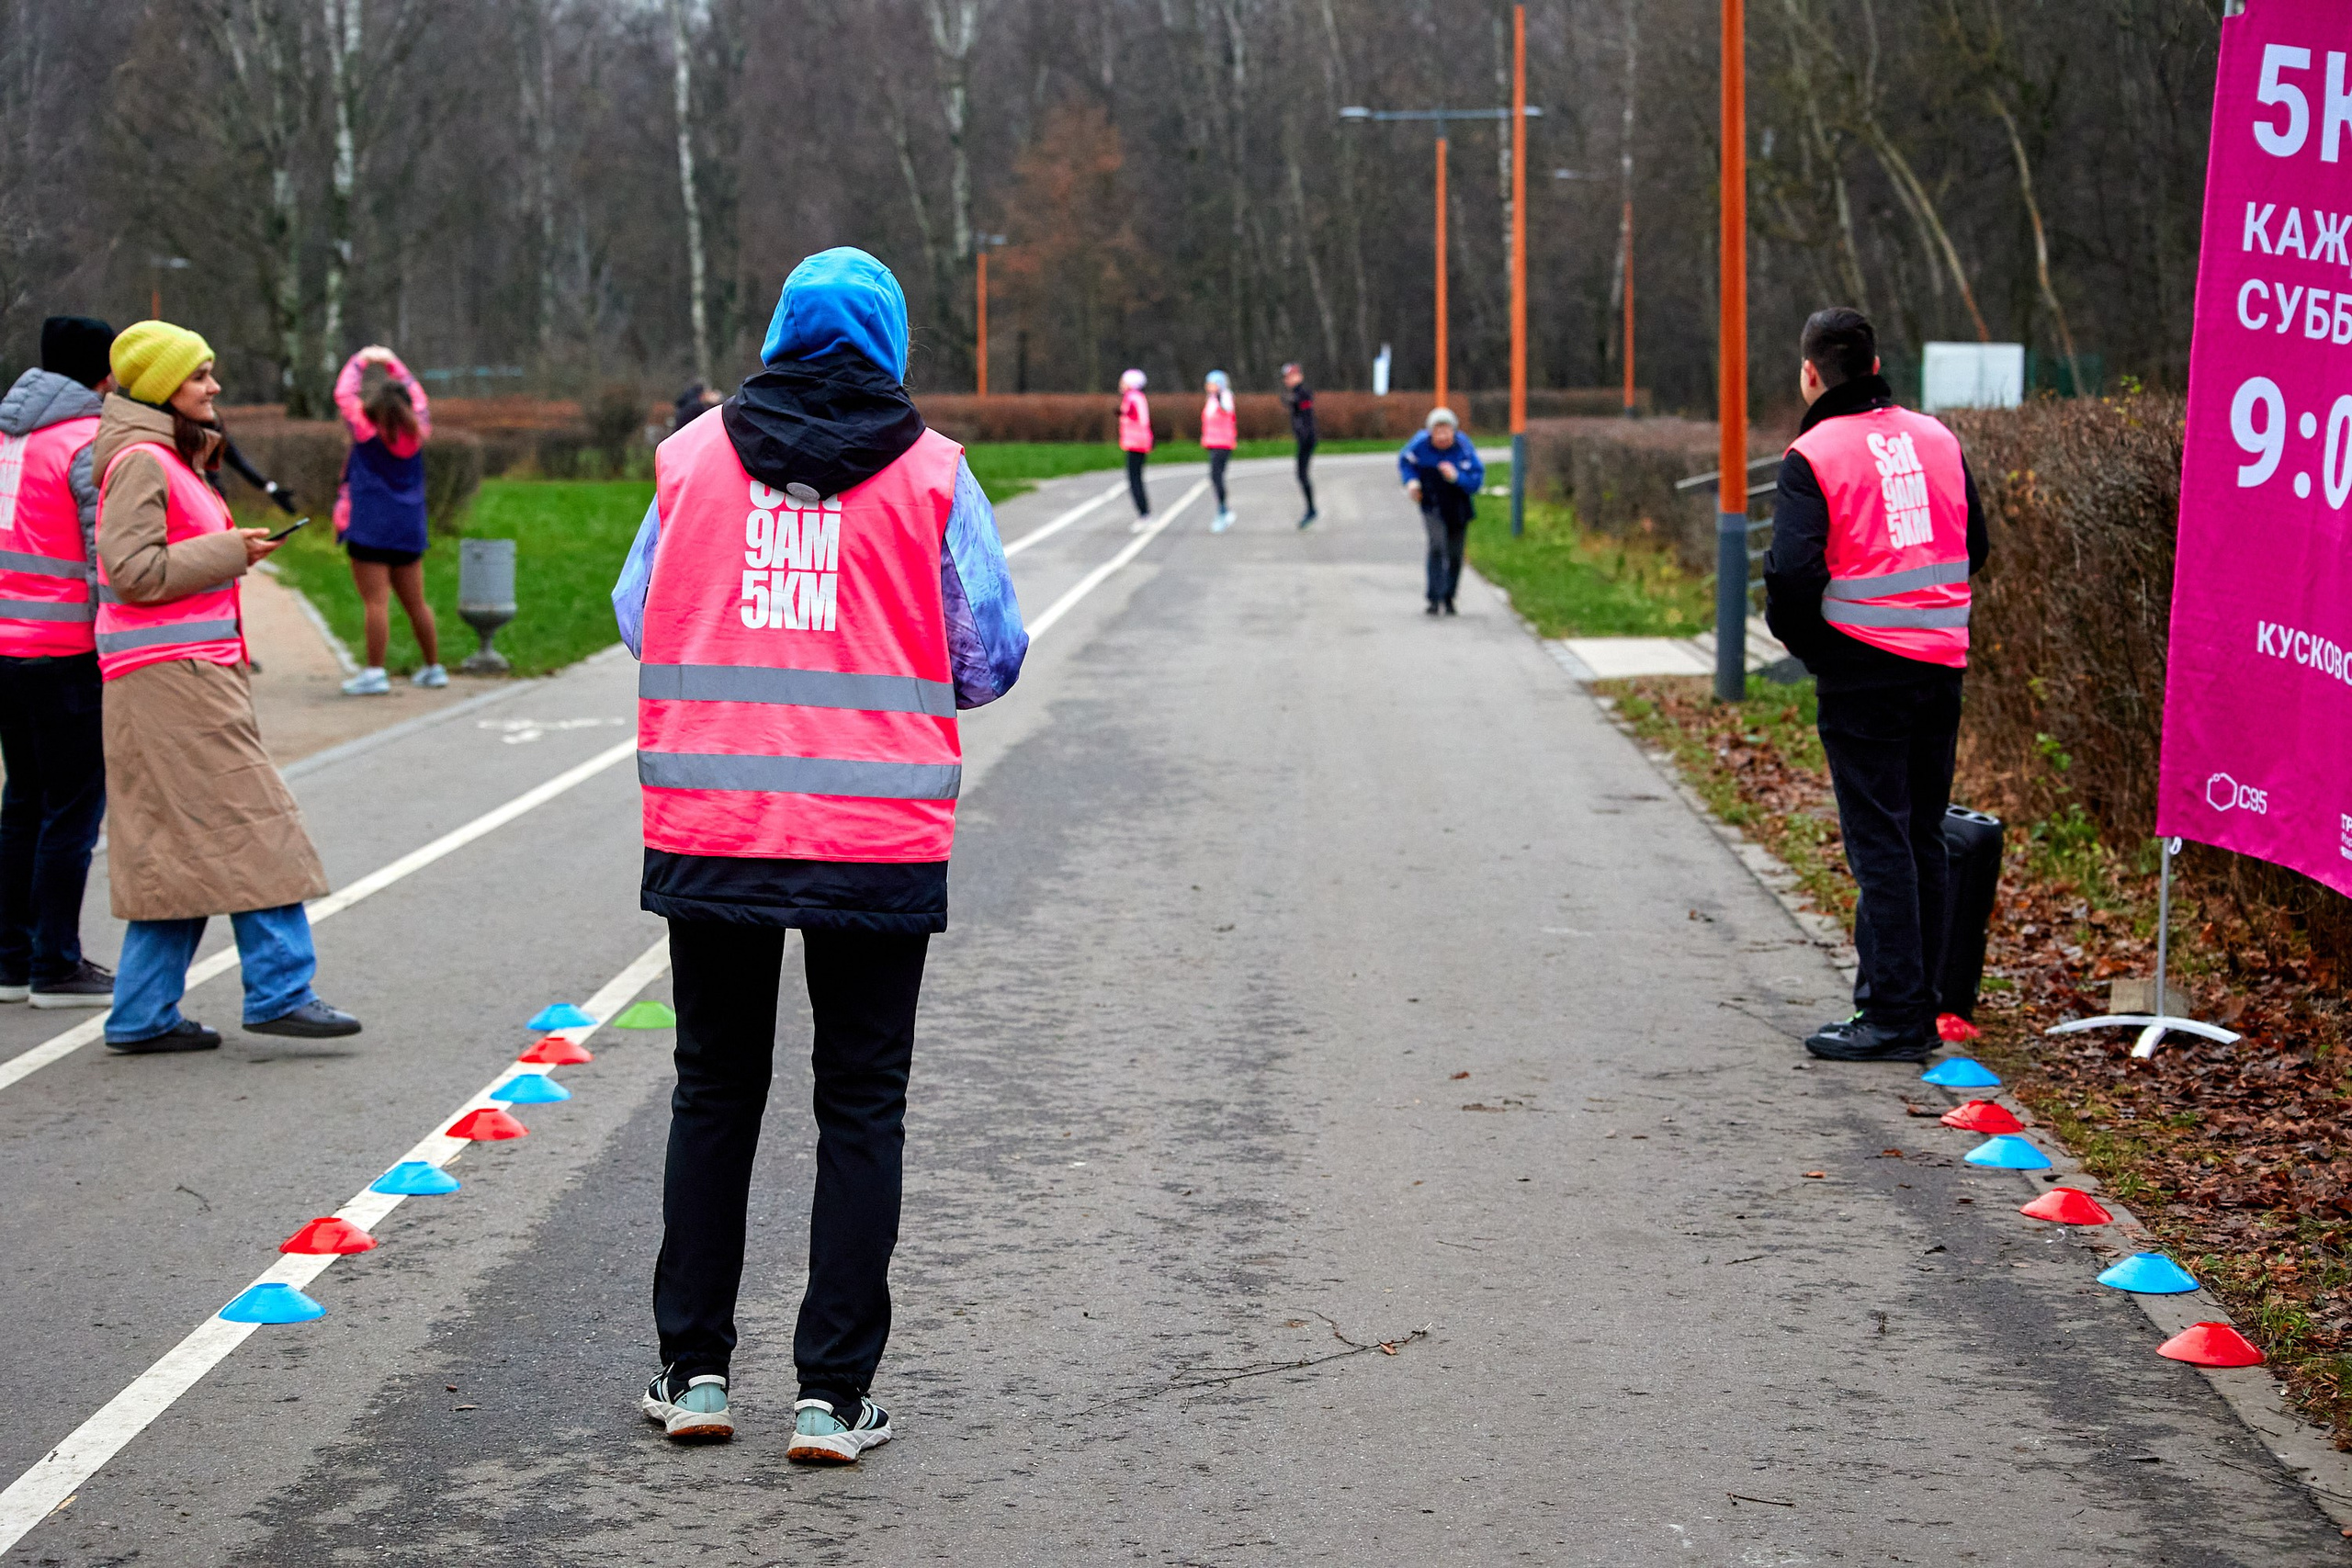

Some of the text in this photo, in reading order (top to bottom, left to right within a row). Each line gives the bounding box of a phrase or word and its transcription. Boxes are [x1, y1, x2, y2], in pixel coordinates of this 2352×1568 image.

[2243, 201, 2352, 279] КАЖ
[2237, 278, 2352, 345] СУББ
[1867, 432, 1923, 478] Sat
[2230, 376, 2352, 510] 9:0
[1882, 472, 1929, 513] 9AM
[745, 509, 842, 570] 9AM
[1886, 507, 1934, 549] 5KM
[741, 570, 838, 632] 5KM
